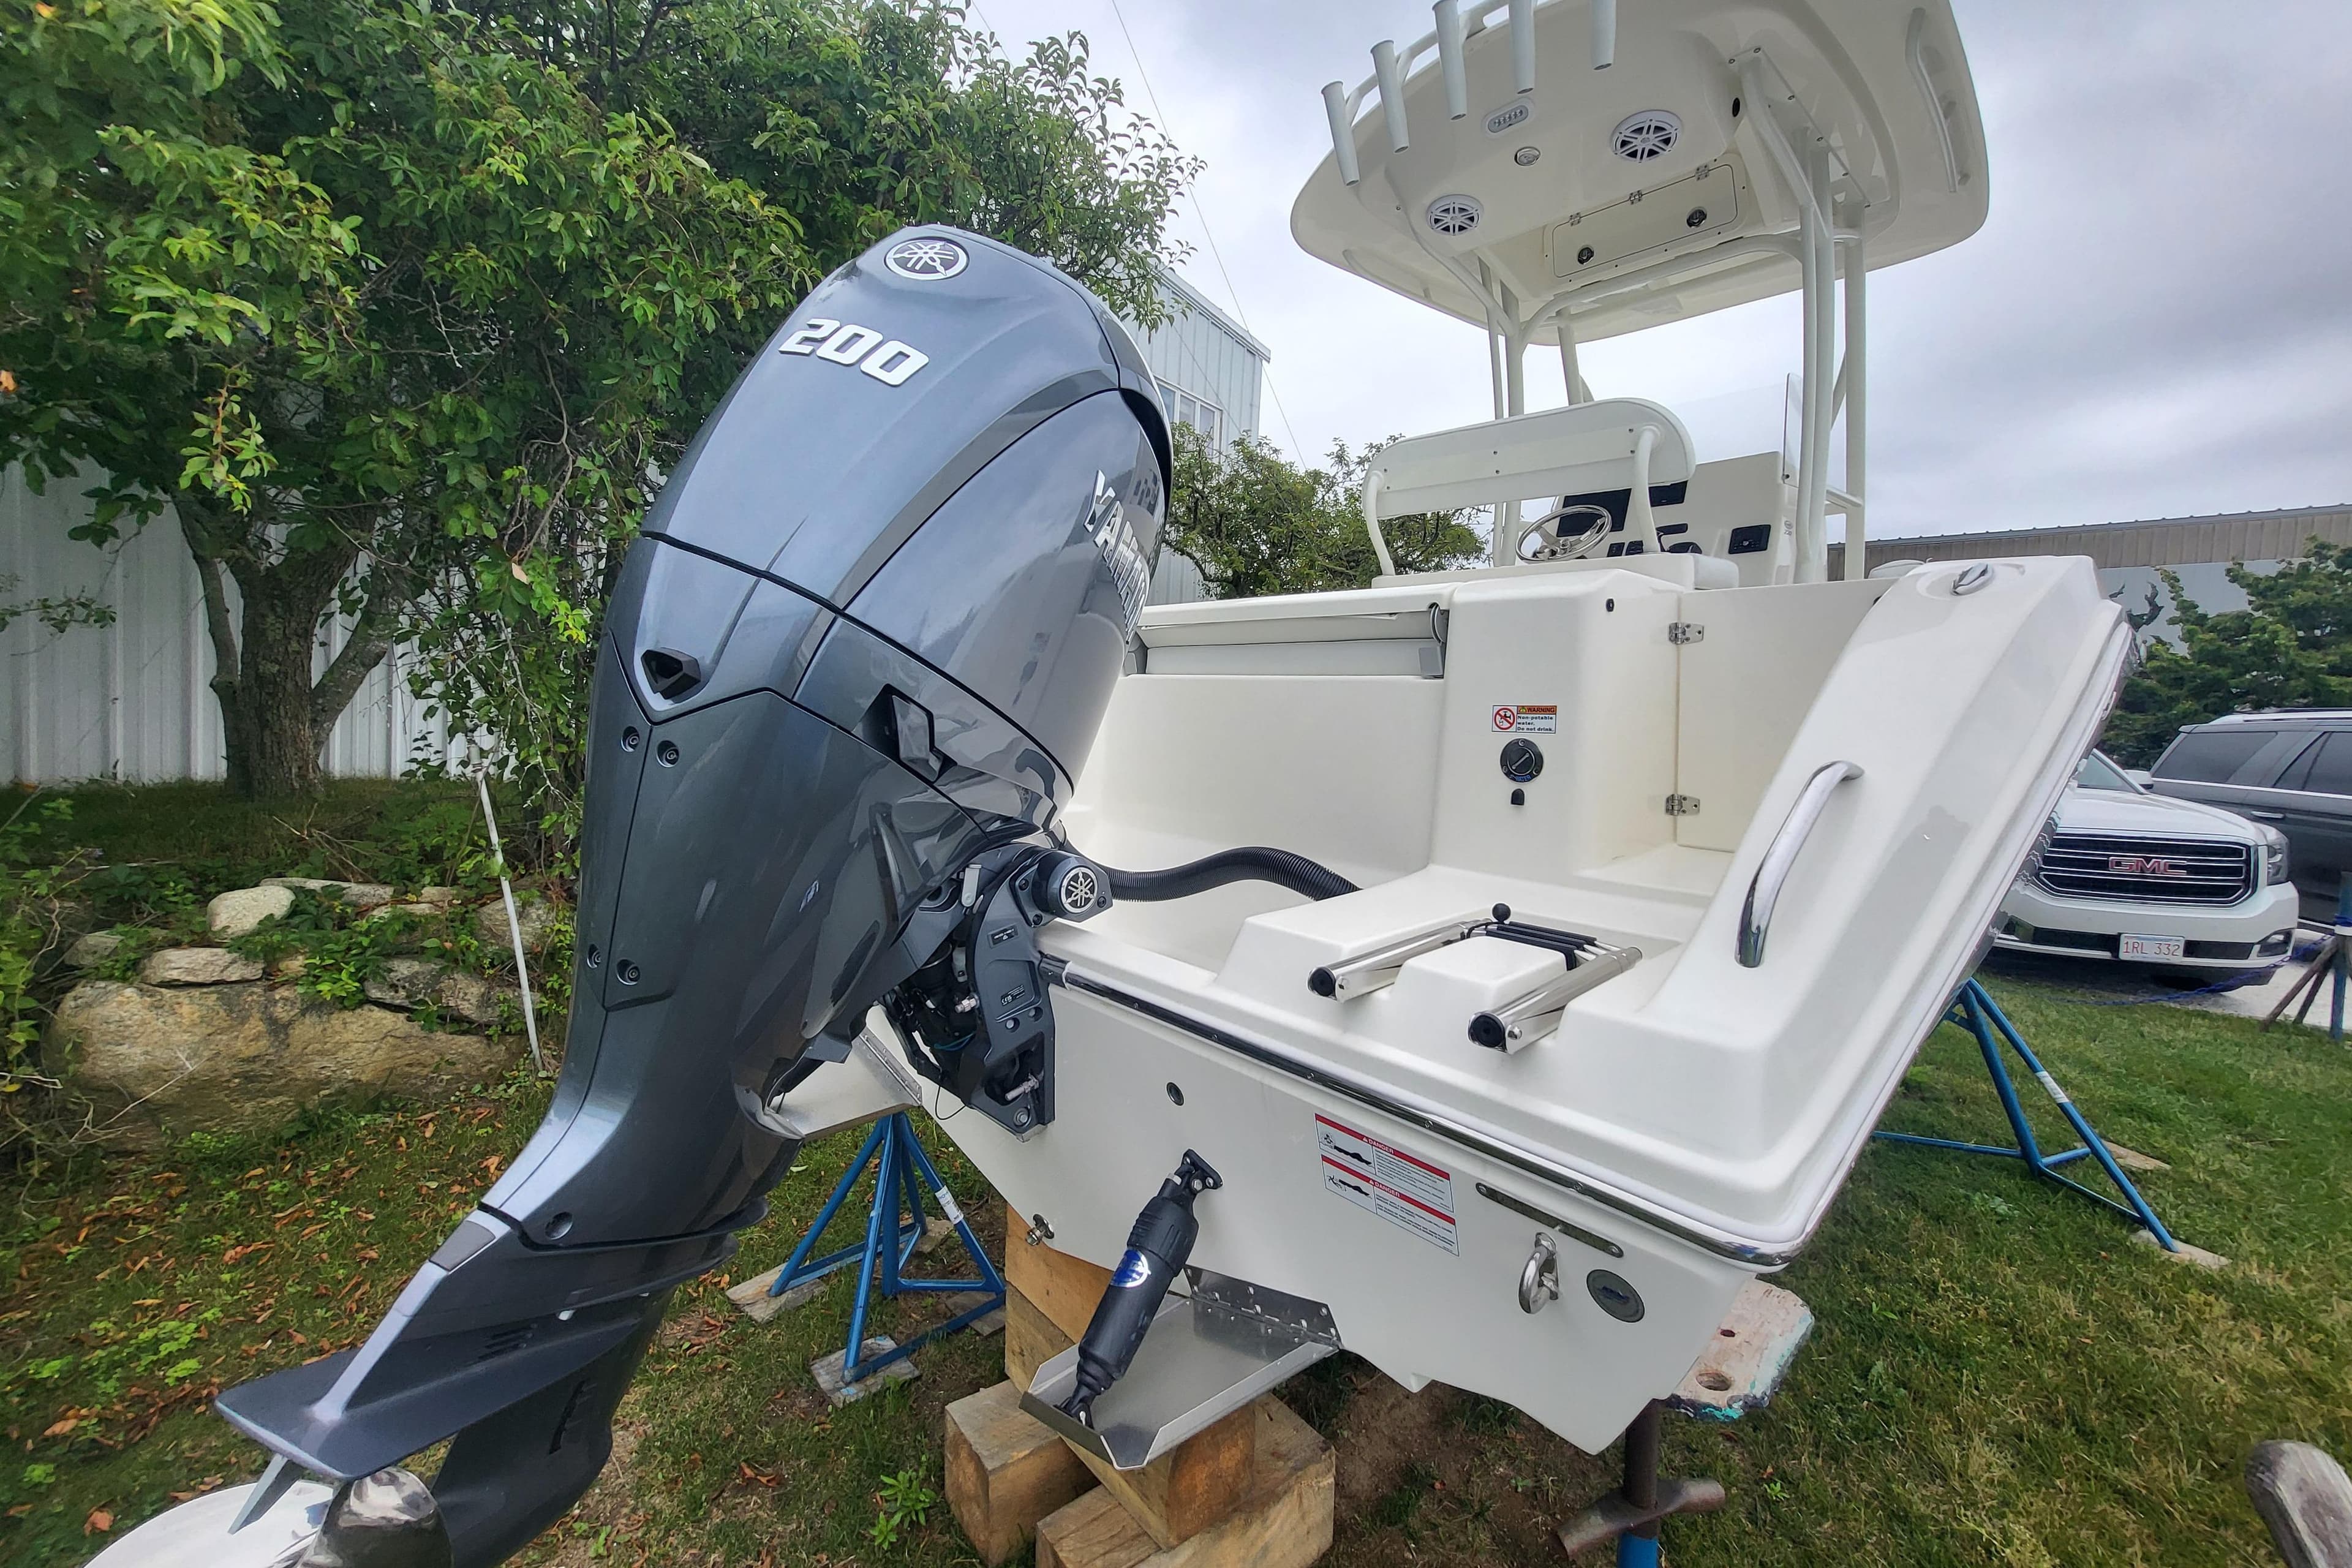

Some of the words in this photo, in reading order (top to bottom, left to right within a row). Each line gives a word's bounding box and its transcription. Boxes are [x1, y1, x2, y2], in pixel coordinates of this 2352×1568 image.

[778, 318, 930, 387] 200
[2109, 857, 2187, 875] GMC
[2122, 941, 2149, 954] 1RL
[2154, 942, 2180, 956] 332
[1368, 1139, 1394, 1155] DANGER
[1374, 1181, 1400, 1197] DANGER
